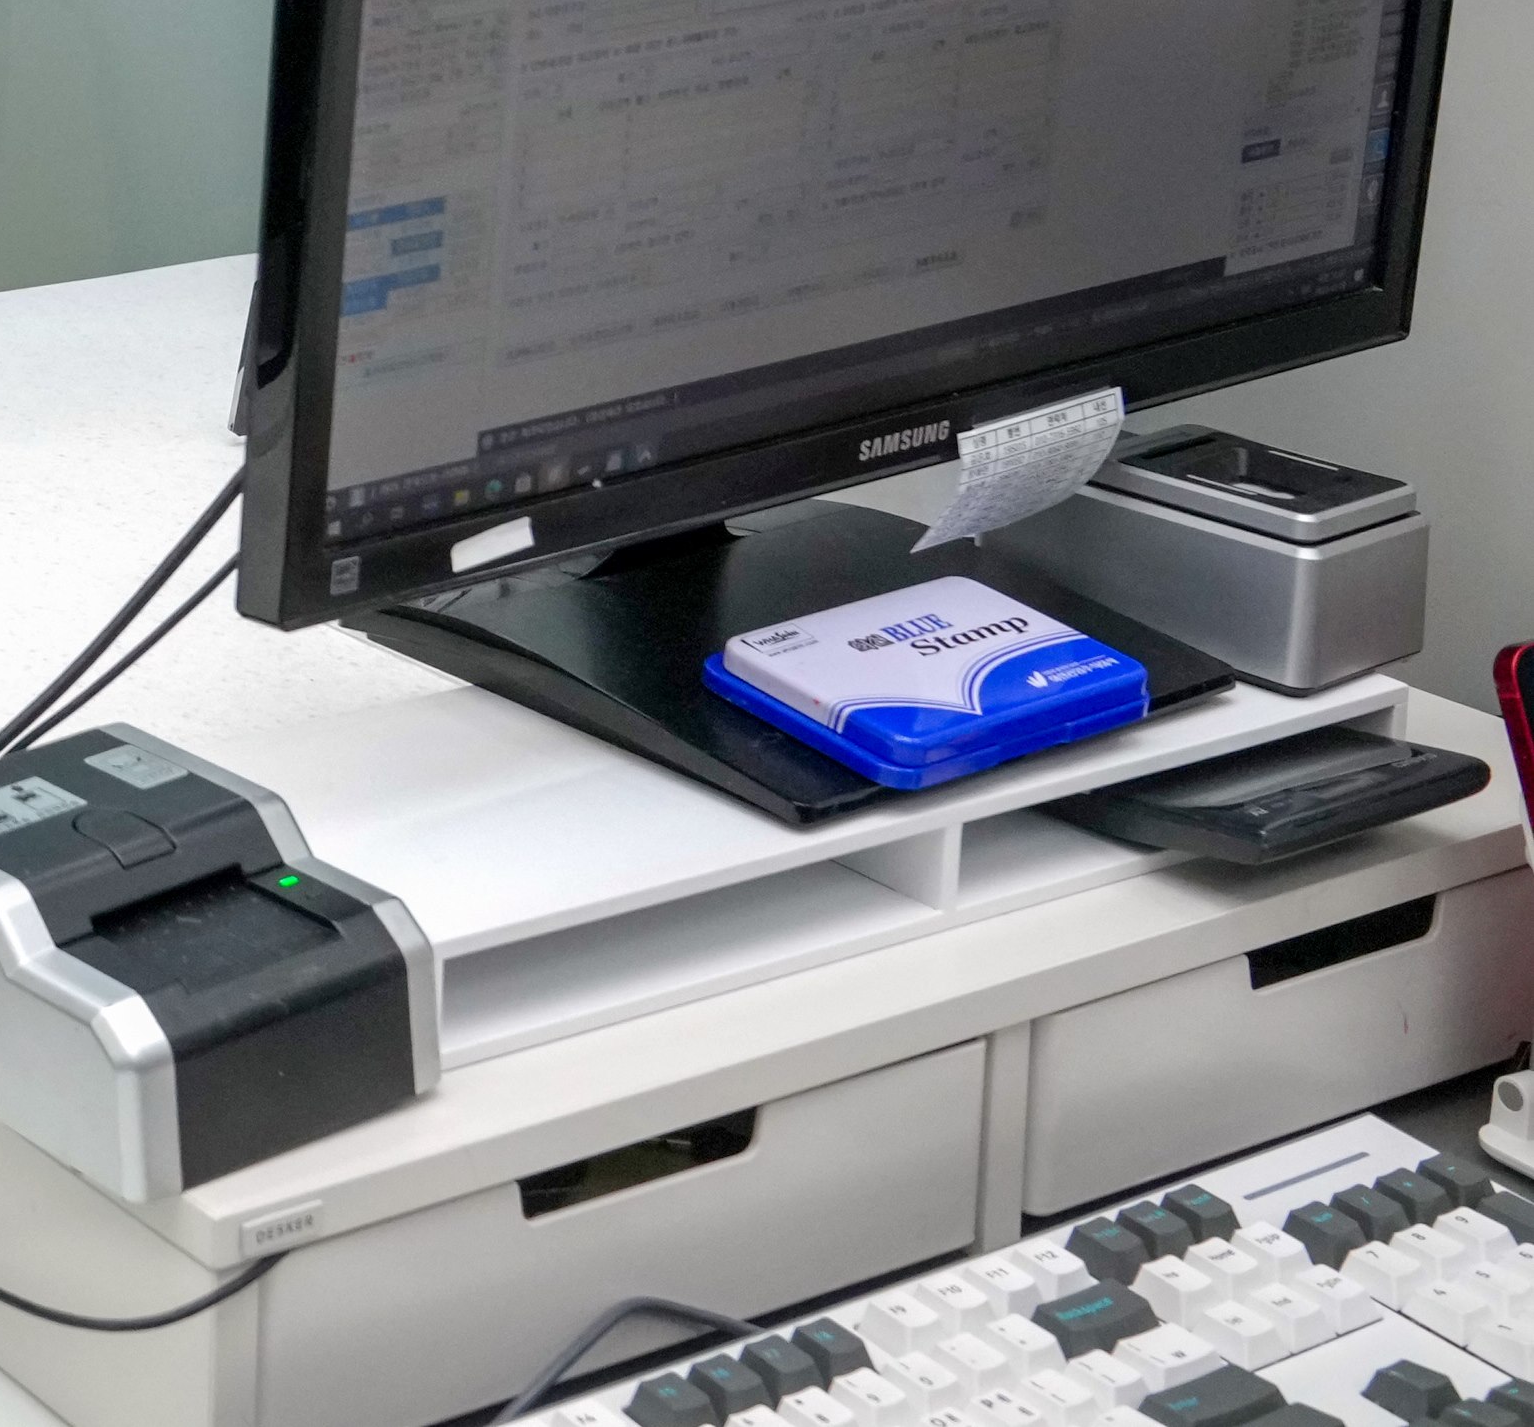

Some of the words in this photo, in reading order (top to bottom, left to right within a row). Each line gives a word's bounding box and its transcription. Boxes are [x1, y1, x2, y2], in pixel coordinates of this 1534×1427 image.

[859, 421, 950, 462] SAMSUNG
[879, 613, 954, 642] BLUE
[911, 615, 1030, 657] Stamp
[1454, 1215, 1469, 1225] 9
[1411, 1232, 1427, 1241] 8
[1034, 1249, 1058, 1263] F12
[985, 1266, 1010, 1281] F11
